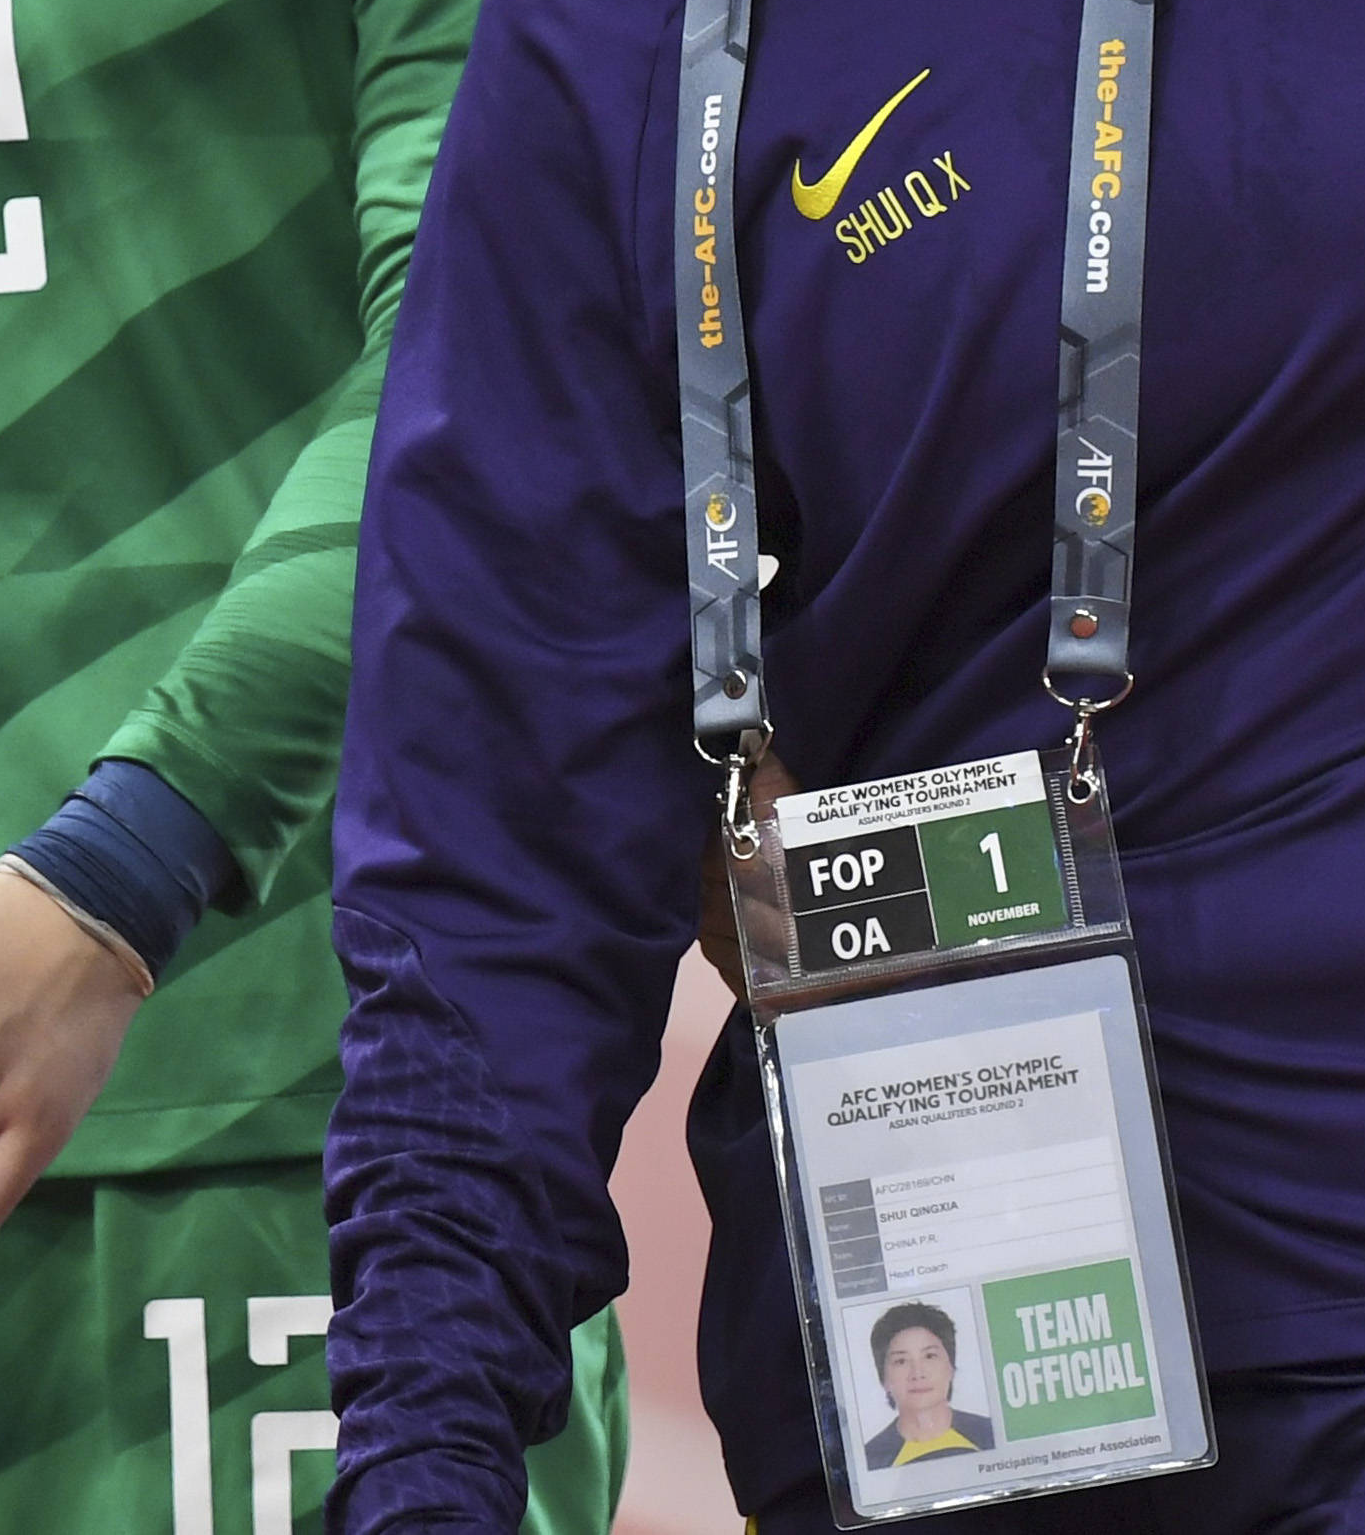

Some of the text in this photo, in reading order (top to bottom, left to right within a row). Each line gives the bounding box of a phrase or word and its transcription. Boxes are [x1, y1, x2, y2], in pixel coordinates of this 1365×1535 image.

[1085, 38, 1127, 294] the-AFC.com
[694, 94, 723, 349] the-AFC.com
[835, 186, 913, 264] SHUI
[1075, 435, 1113, 527] AFC
[704, 491, 740, 581] AFC
[806, 773, 1018, 825] QUALIFYING TOURNAMENT
[817, 761, 1004, 808] AFC WOMEN'S OLYMPIC
[858, 813, 885, 826] ASIAN
[885, 805, 933, 823] QUALIFIERS
[933, 799, 964, 812] ROUND
[808, 848, 885, 897] FOP
[979, 832, 1009, 894] 1
[831, 917, 892, 961] OA
[967, 902, 1041, 927] NOVEMBER
[826, 1069, 1079, 1127] QUALIFYING TOURNAMENT
[840, 1055, 1063, 1108] AFC WOMEN'S OLYMPIC
[888, 1116, 919, 1130] ASIAN
[921, 1106, 978, 1125] QUALIFIERS
[979, 1099, 1016, 1114] ROUND
[879, 1200, 959, 1224] SHUI QINGXIA
[1015, 1293, 1113, 1353] TEAM
[1002, 1342, 1146, 1409] OFFICIAL
[978, 1433, 1162, 1474] Participating Member Association
